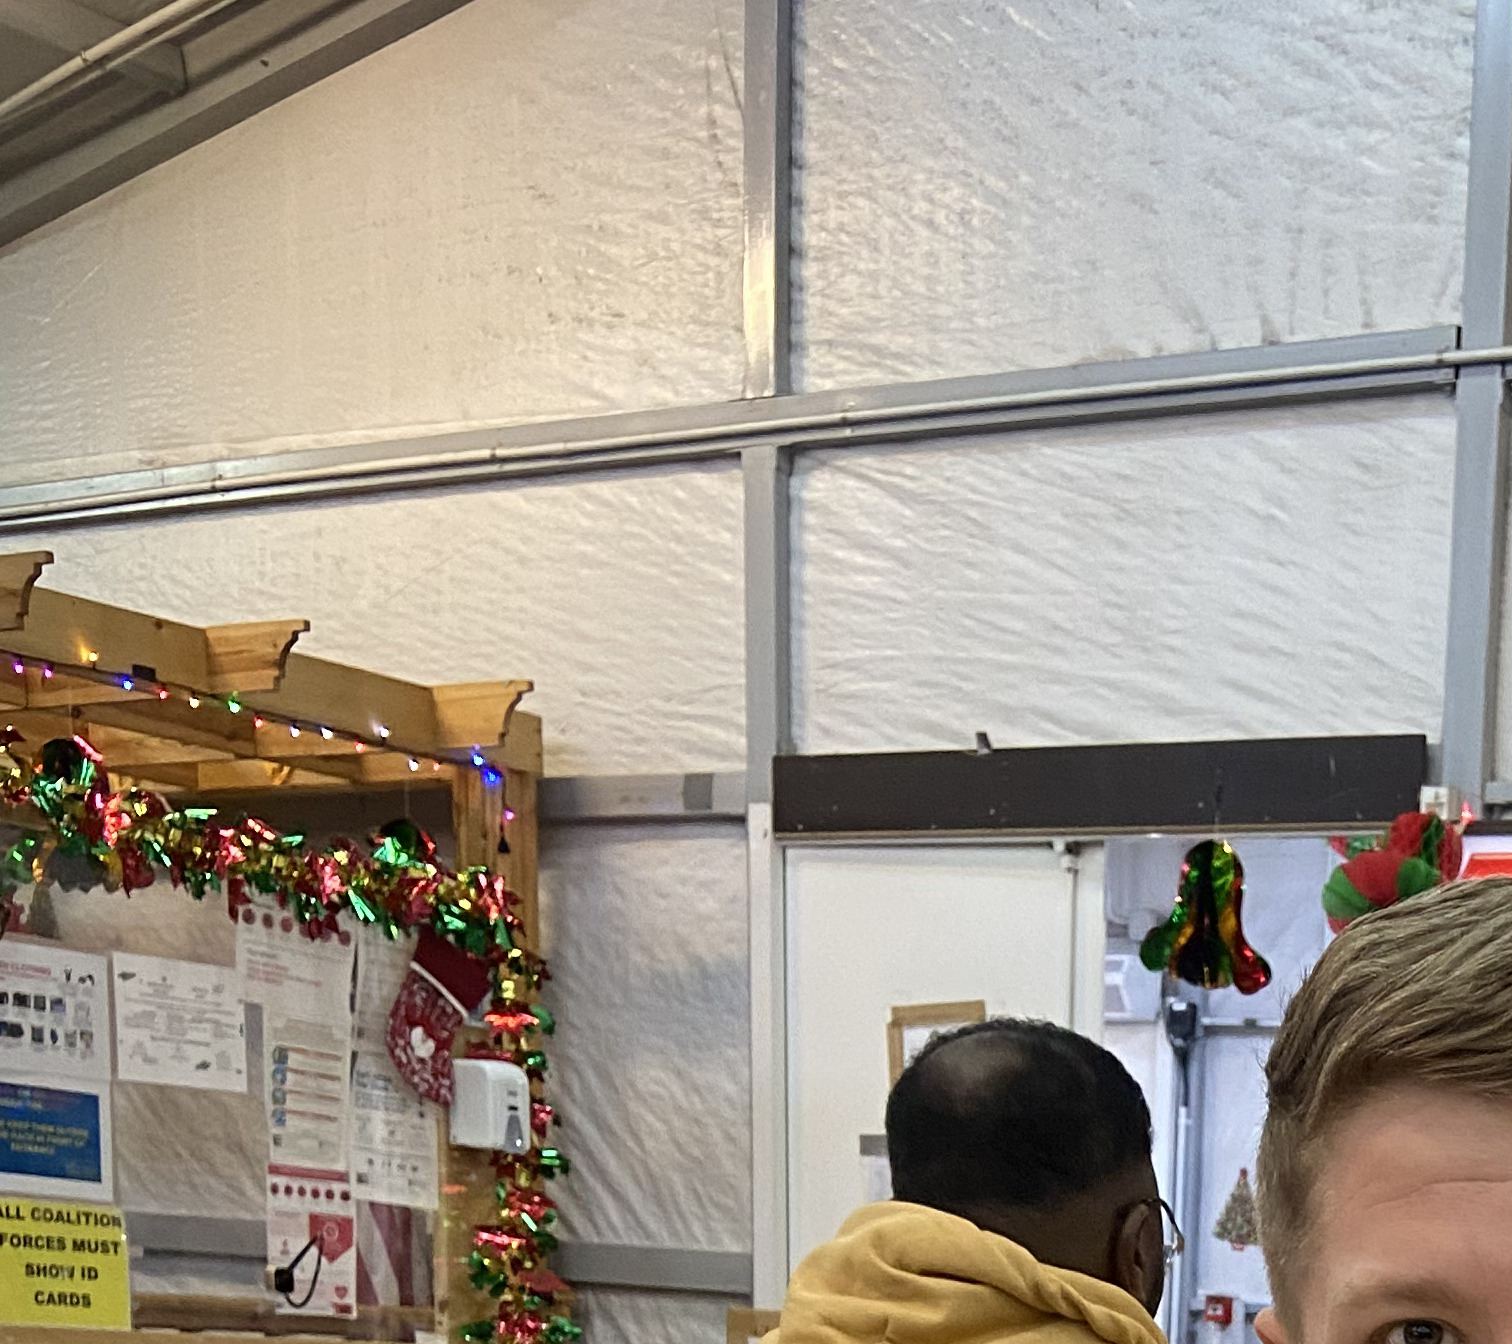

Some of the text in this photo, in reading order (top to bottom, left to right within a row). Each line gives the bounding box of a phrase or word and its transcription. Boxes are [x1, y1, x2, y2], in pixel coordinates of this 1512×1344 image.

[30, 1206, 122, 1229] COALITION
[0, 1232, 121, 1256] FORCES MUST
[24, 1261, 98, 1281] SHOW ID
[34, 1290, 91, 1309] CARDS
